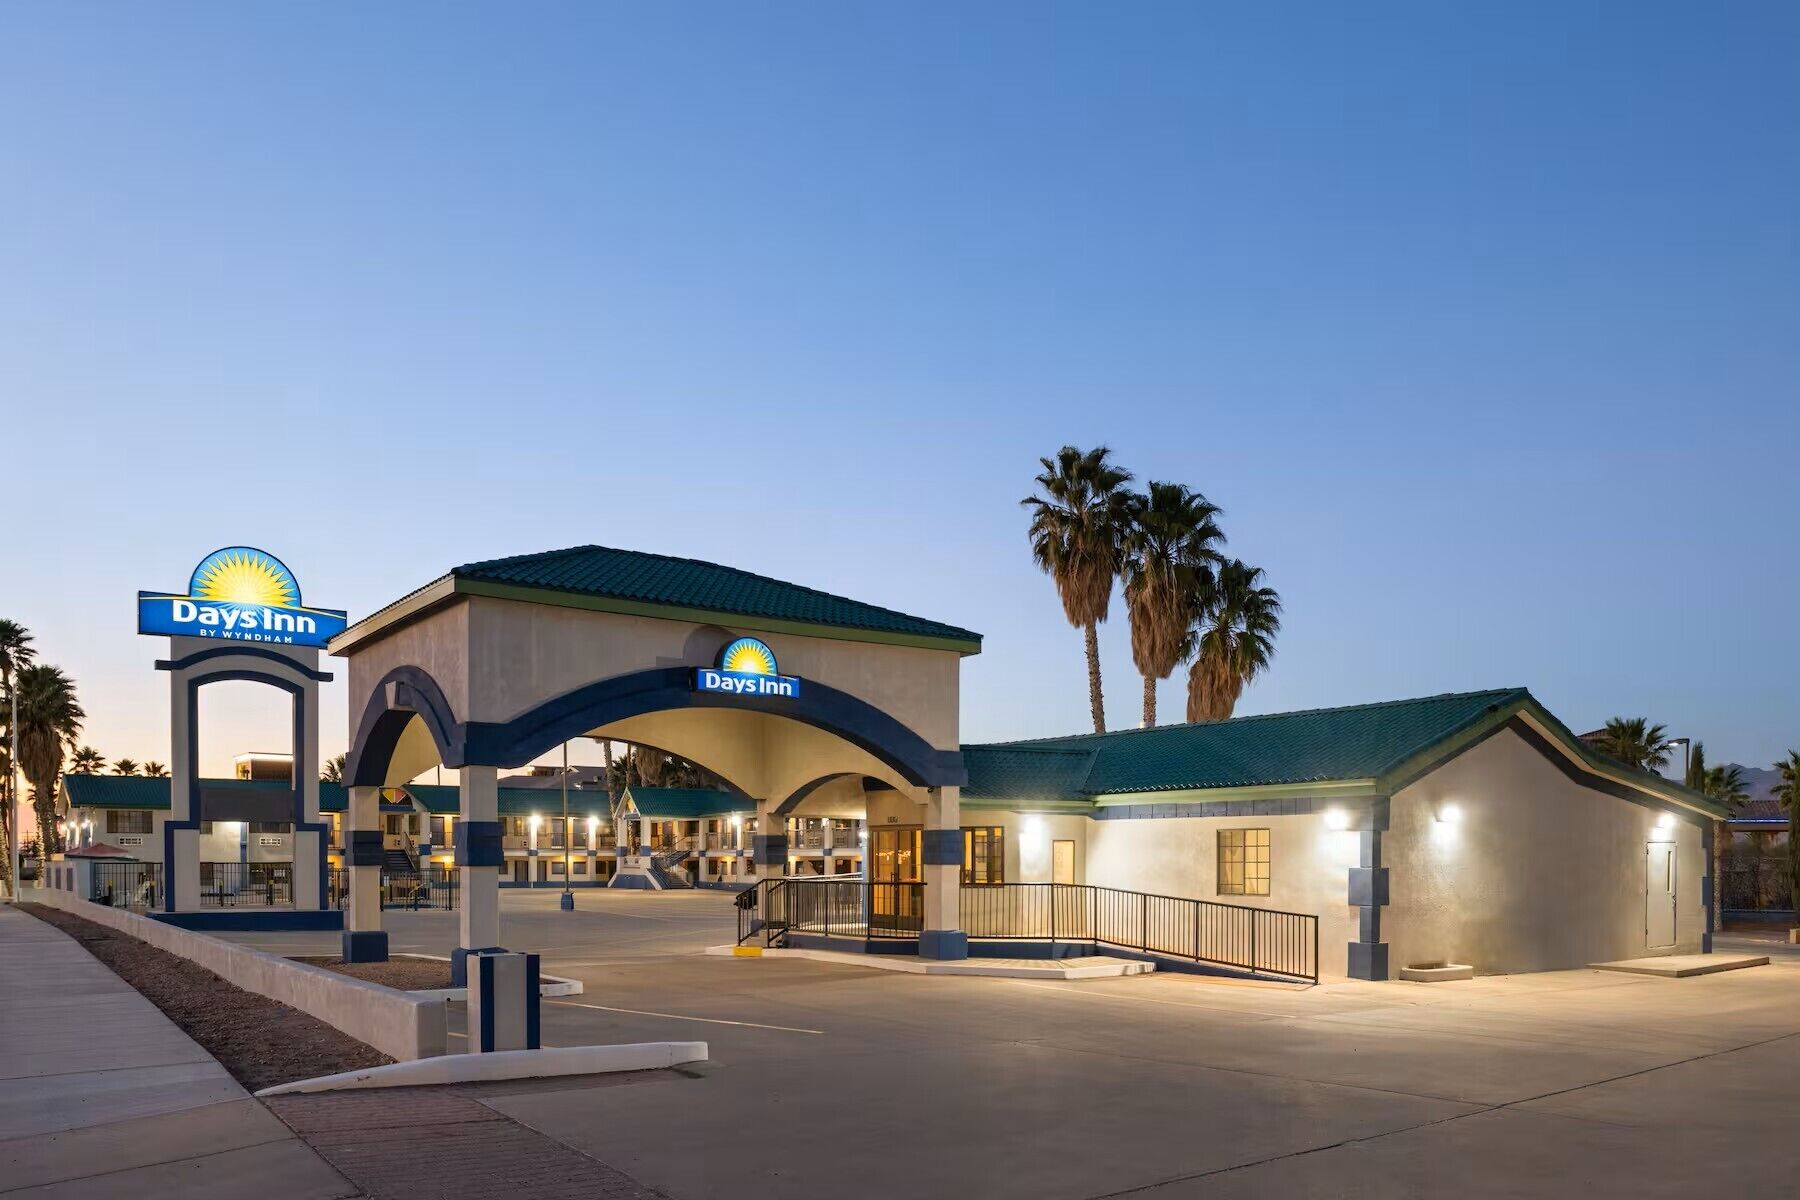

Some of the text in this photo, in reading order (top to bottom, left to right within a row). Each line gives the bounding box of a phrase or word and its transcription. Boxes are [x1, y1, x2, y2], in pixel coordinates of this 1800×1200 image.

[173, 600, 316, 634] Days Inn
[200, 629, 292, 643] BY WYNDHAM
[706, 672, 792, 696] Days Inn
